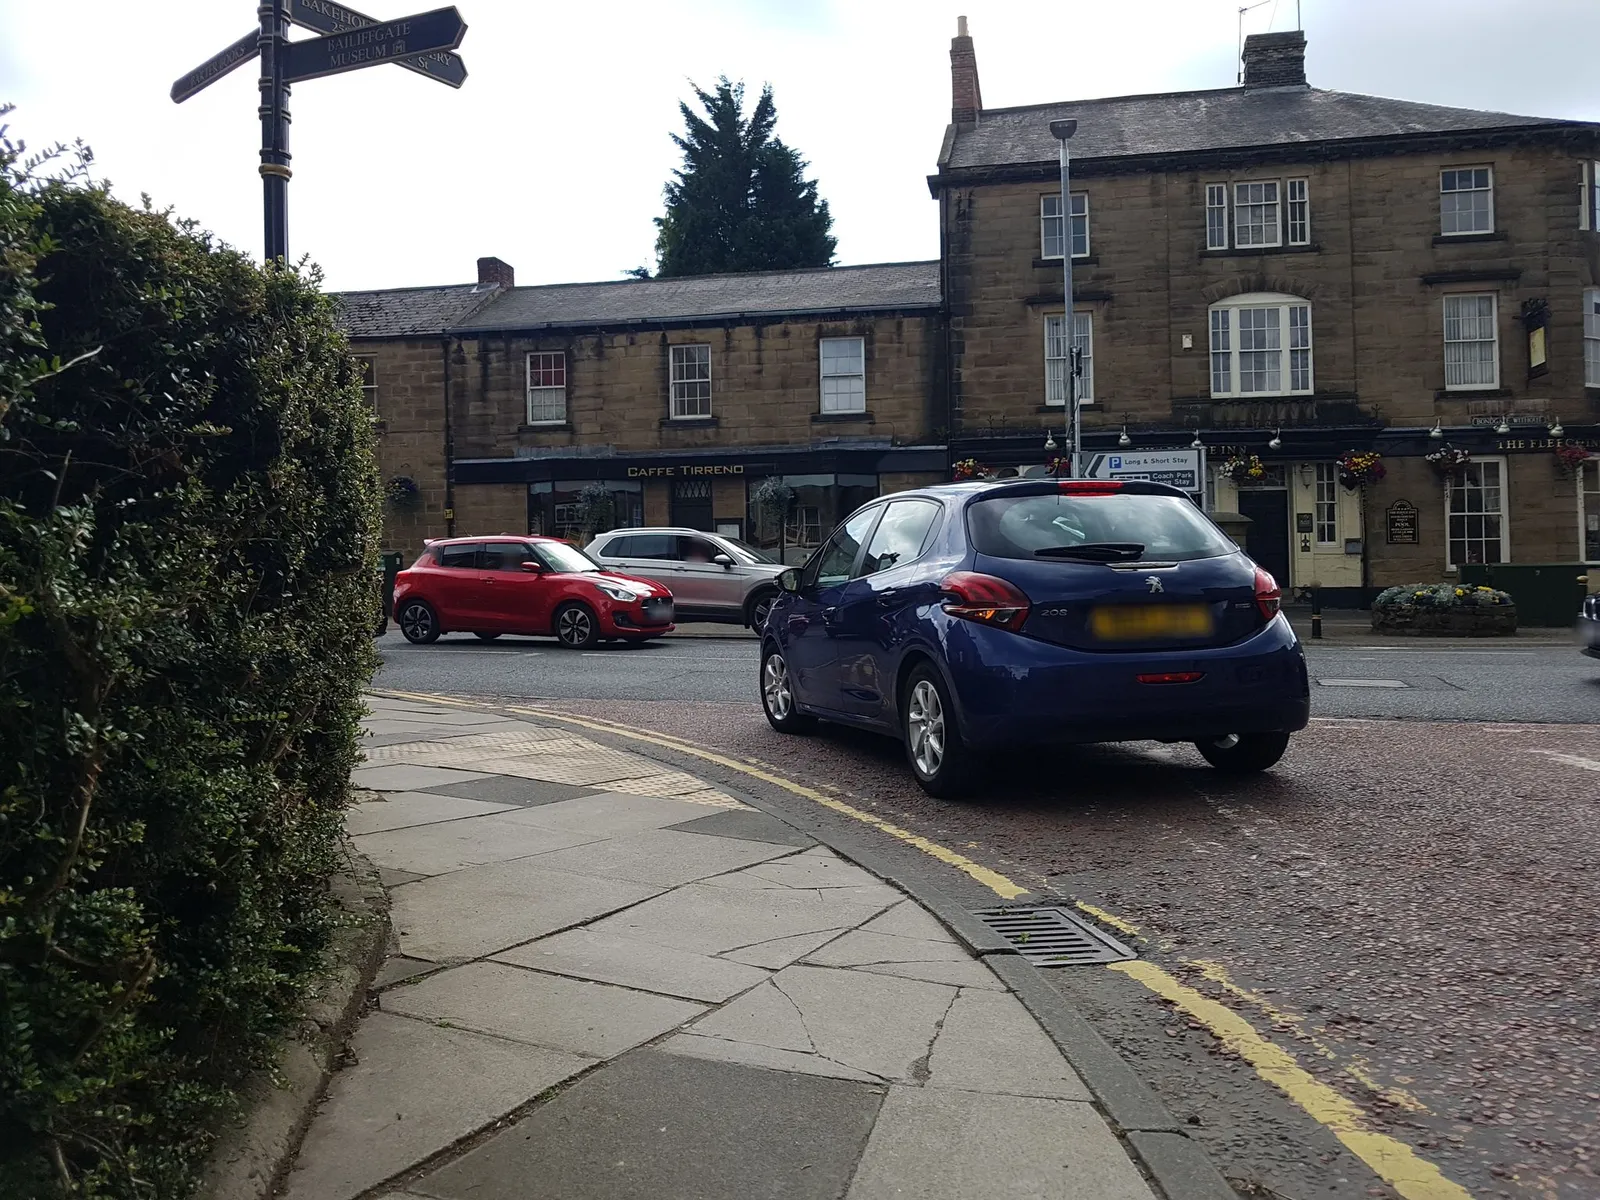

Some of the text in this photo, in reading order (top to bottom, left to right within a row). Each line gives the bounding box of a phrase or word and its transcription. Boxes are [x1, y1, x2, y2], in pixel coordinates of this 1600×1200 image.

[328, 21, 411, 52] BAILIFFGATE
[330, 44, 386, 68] MUSEUM
[1221, 445, 1247, 454] INN
[1497, 440, 1526, 449] THE
[627, 465, 744, 477] CAFFE TIRRENO
[1040, 608, 1068, 617] 208
